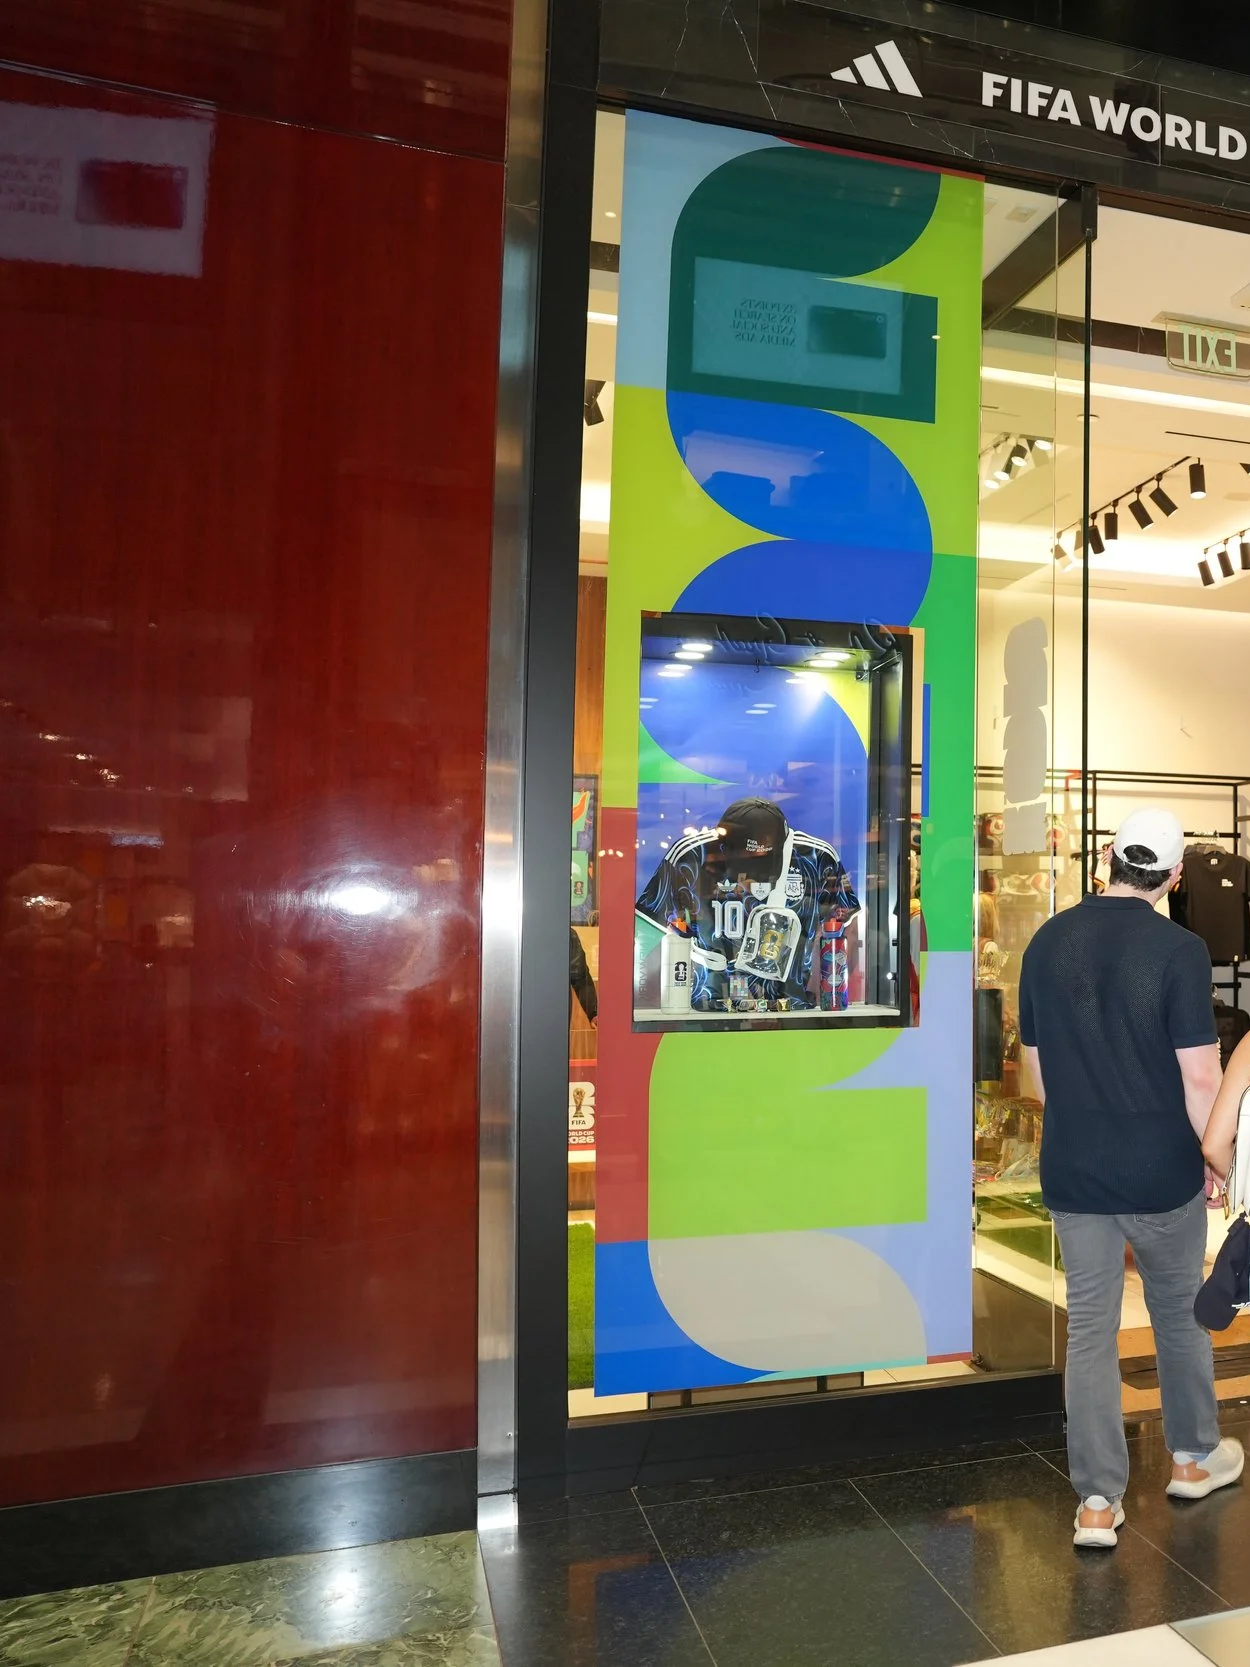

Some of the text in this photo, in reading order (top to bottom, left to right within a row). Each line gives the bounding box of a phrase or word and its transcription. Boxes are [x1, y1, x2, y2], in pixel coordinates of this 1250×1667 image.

[981, 71, 1082, 127] FIFA
[1088, 95, 1248, 161] WORLD
[711, 900, 745, 939] 10
[568, 1135, 595, 1145] 026
